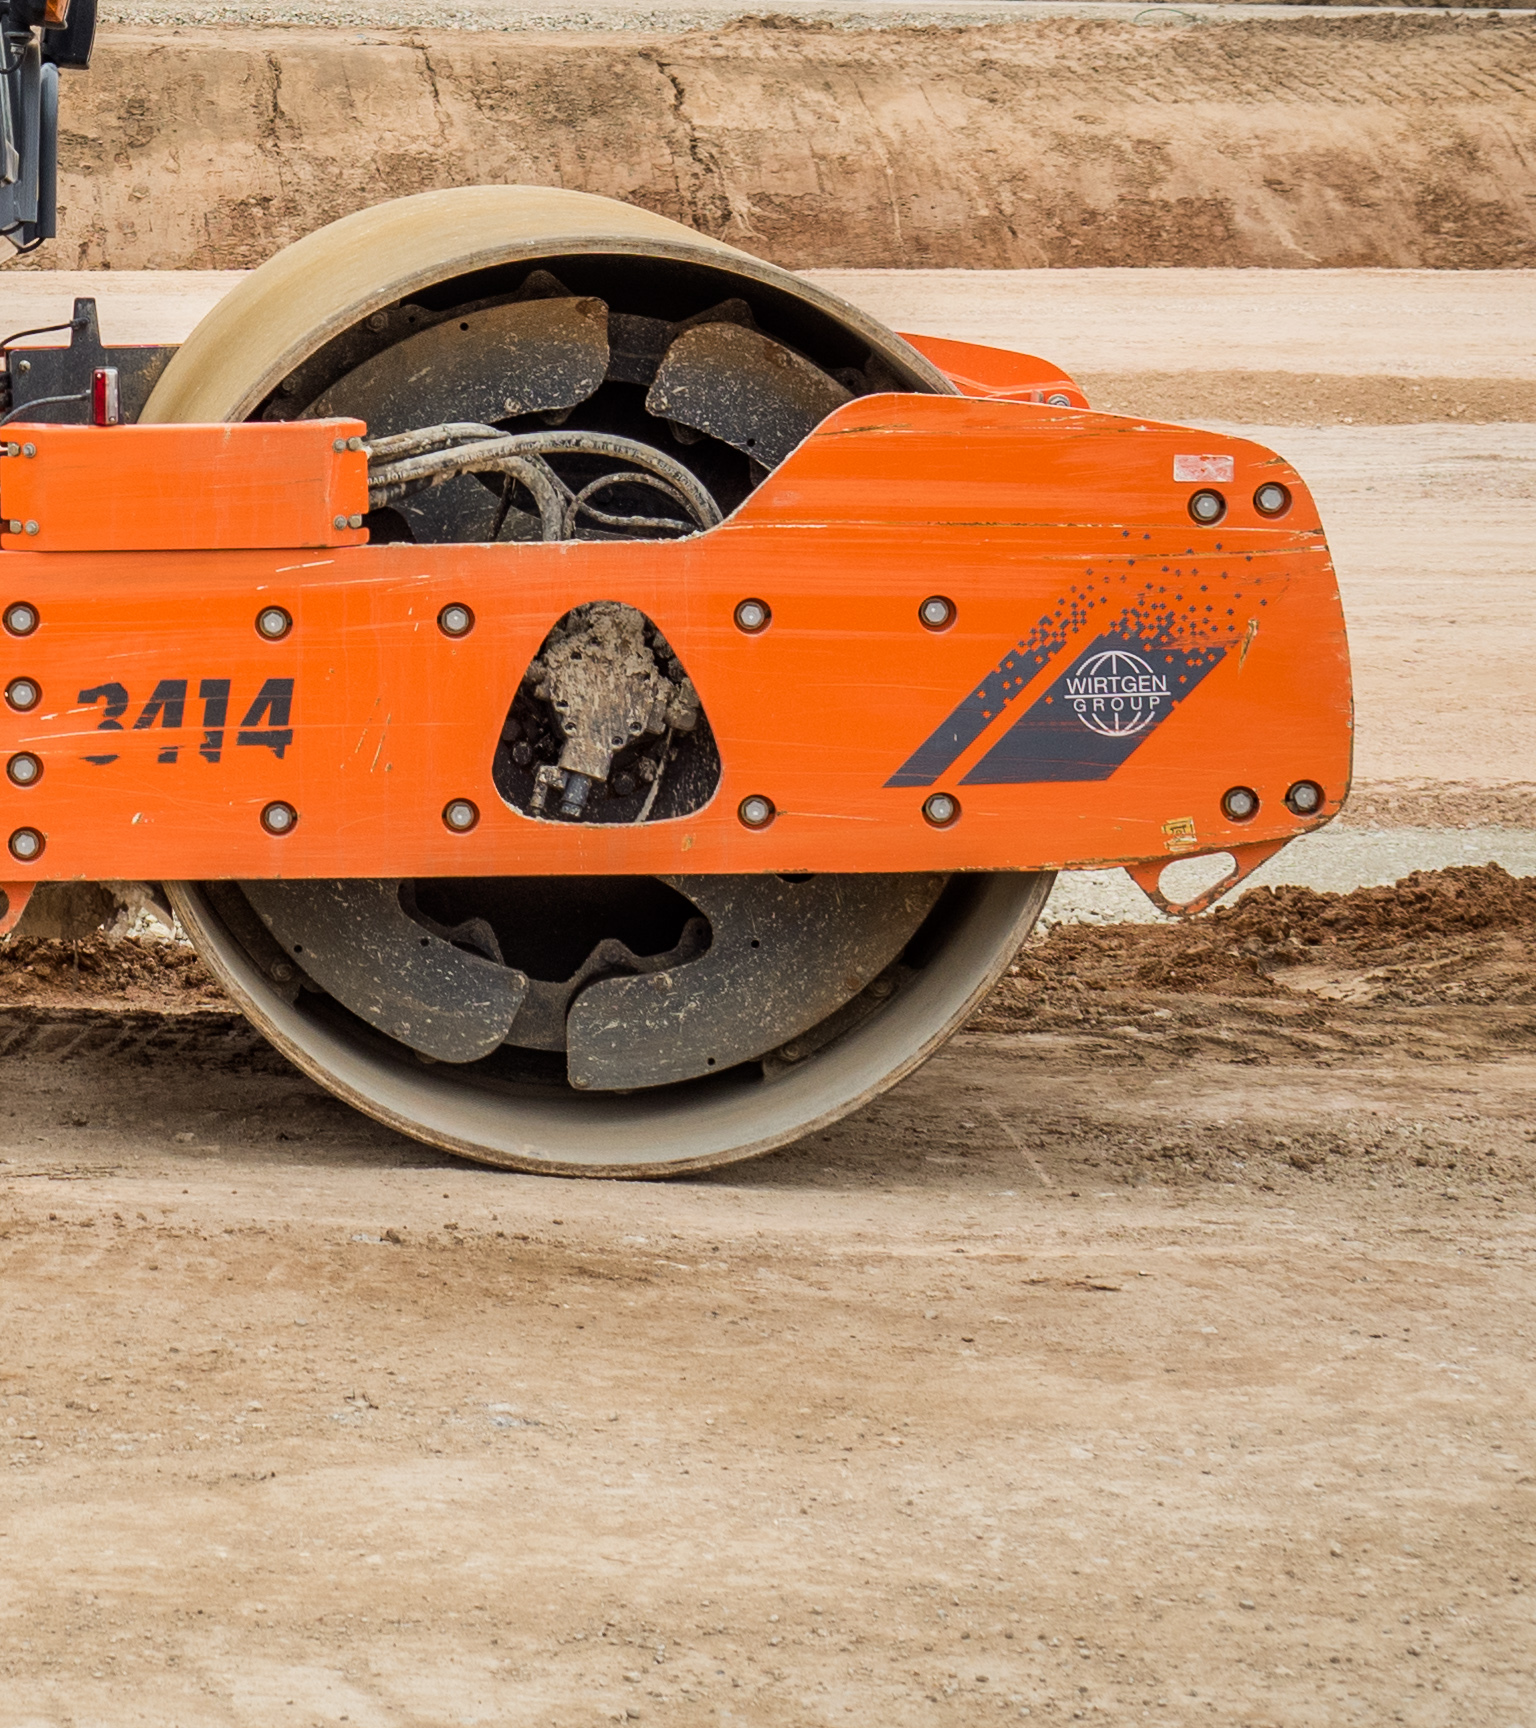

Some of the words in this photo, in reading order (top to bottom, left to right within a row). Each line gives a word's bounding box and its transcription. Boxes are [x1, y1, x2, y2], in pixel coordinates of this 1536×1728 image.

[1066, 674, 1167, 694] WIRTGEN
[1073, 696, 1160, 712] GROUP
[77, 677, 295, 765] 3414
